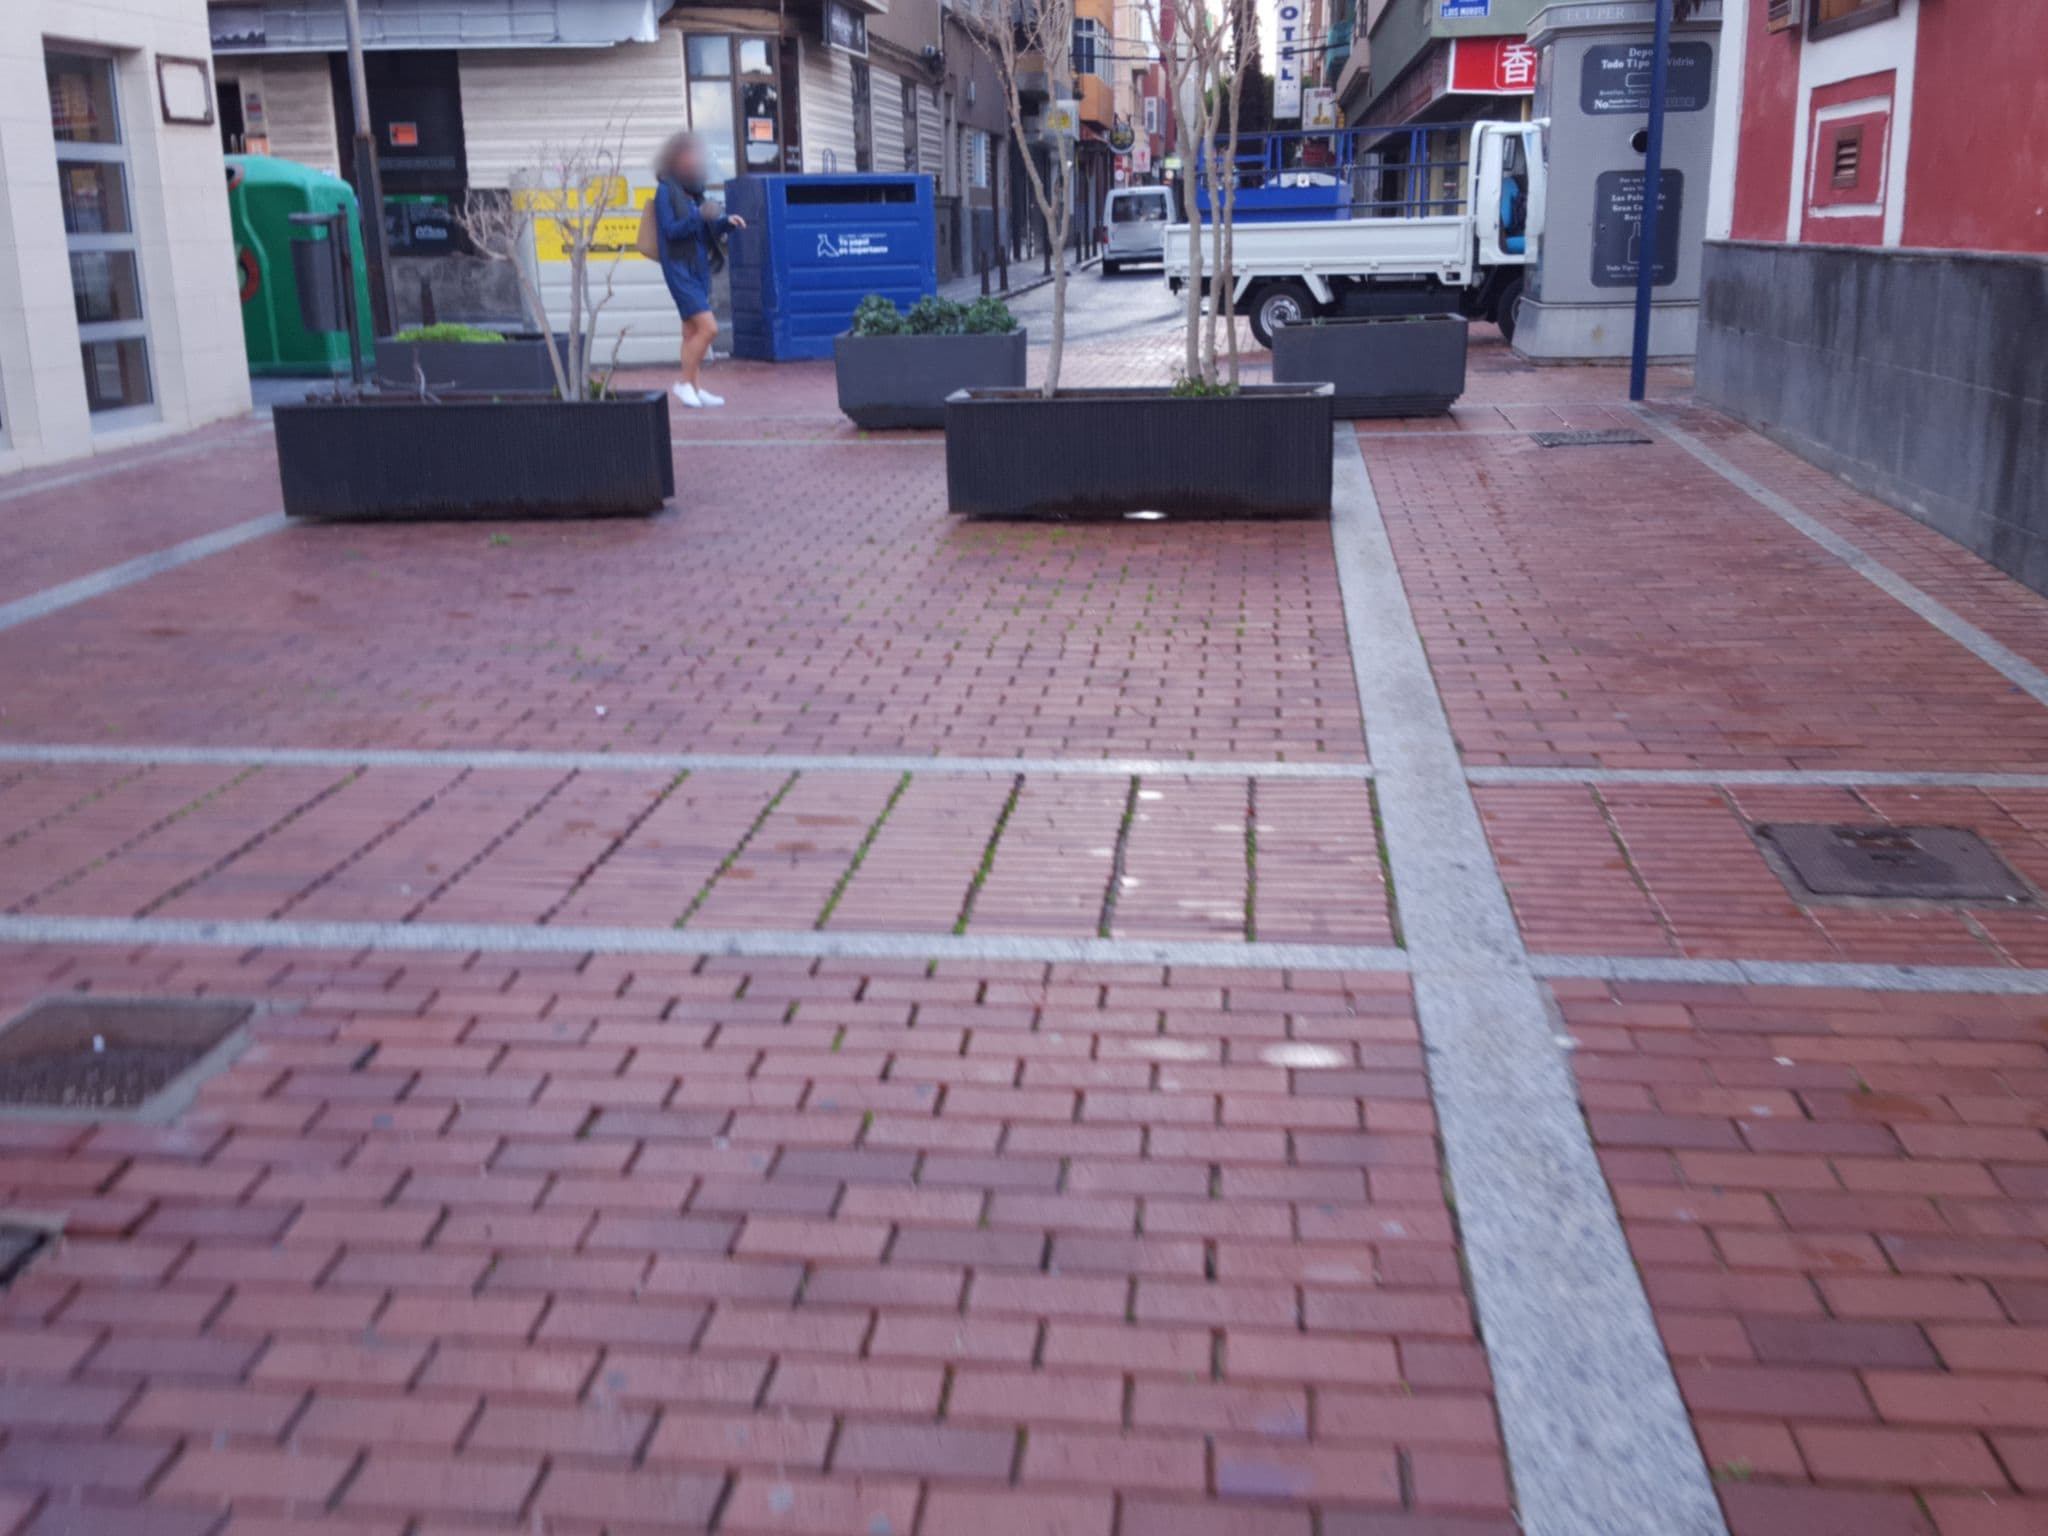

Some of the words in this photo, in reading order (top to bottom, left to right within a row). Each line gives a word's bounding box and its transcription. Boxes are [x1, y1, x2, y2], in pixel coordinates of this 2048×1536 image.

[1280, 6, 1298, 81] OTEL
[1629, 48, 1654, 59] Depo
[1501, 44, 1537, 83] 香
